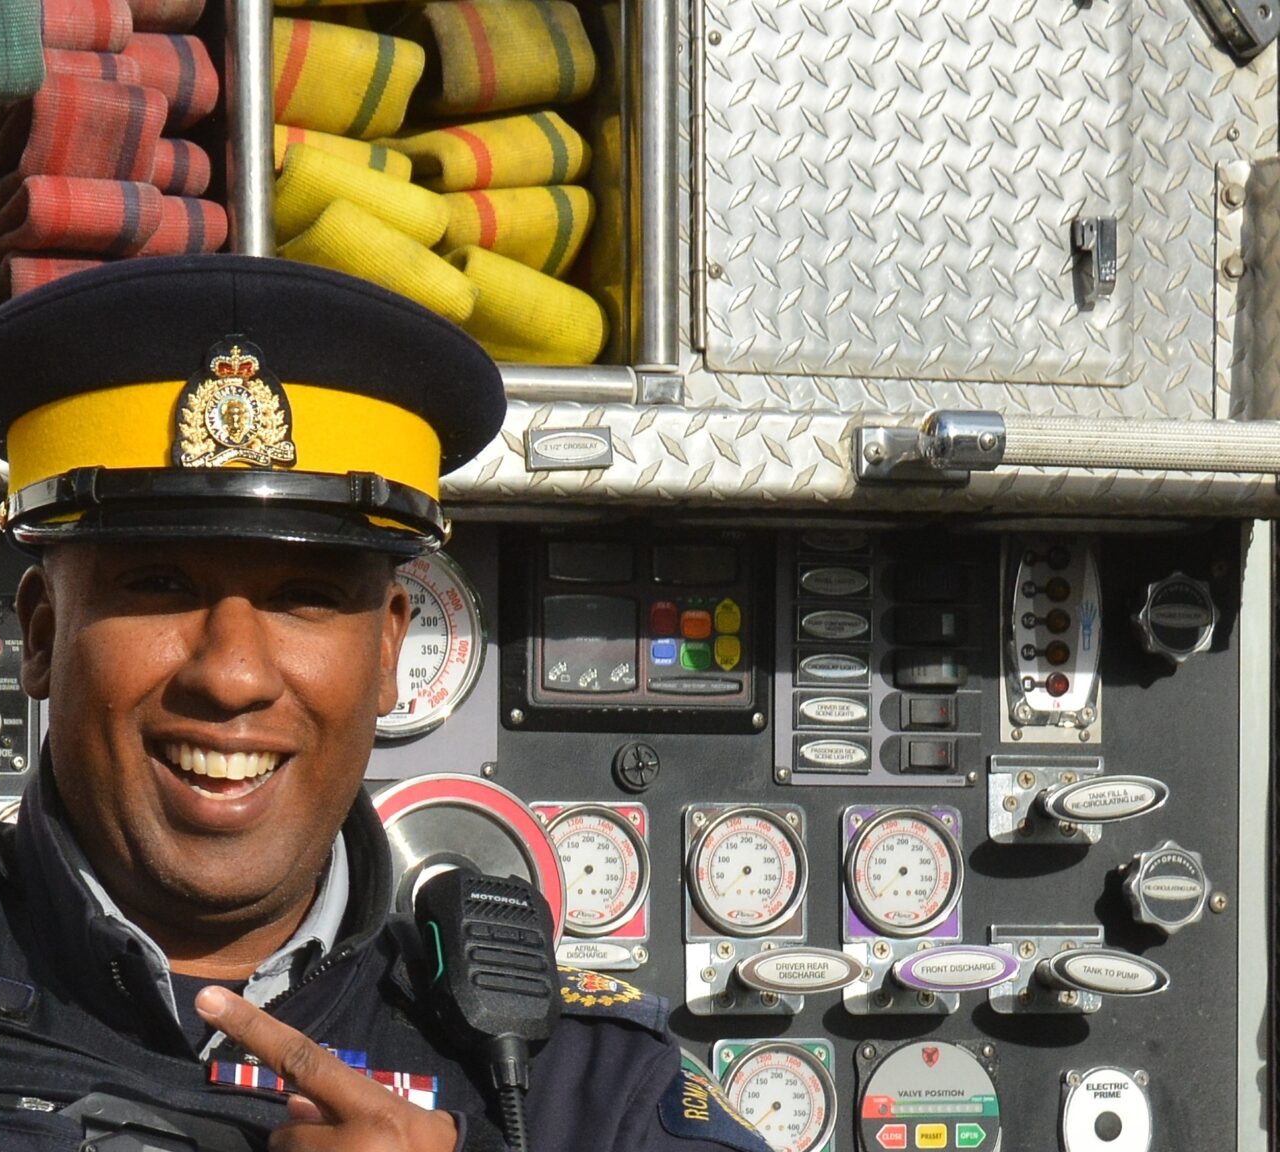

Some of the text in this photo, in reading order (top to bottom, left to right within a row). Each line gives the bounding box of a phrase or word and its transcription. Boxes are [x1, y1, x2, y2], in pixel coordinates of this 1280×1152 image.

[563, 442, 599, 450] CROSSLAY
[409, 593, 426, 605] 250
[446, 587, 463, 612] 2000
[420, 616, 439, 628] 300
[1022, 616, 1036, 626] 1/2
[420, 644, 439, 656] 350
[455, 639, 469, 665] 2400
[408, 667, 427, 679] 400
[410, 679, 424, 691] psi
[427, 686, 450, 710] 2800
[1088, 791, 1107, 801] TANK
[1107, 789, 1122, 799] FILL
[1071, 793, 1146, 811] RE-CIRCULATING LINE
[567, 818, 584, 829] 1200
[597, 819, 615, 832] 1600
[755, 818, 772, 832] 1600
[740, 836, 753, 844] 200
[567, 841, 580, 849] 150
[597, 842, 610, 850] 250
[725, 842, 738, 850] 150
[882, 844, 895, 852] 150
[911, 844, 924, 852] 250
[604, 856, 618, 864] 300
[763, 856, 775, 864] 300
[874, 857, 887, 865] 100
[919, 857, 932, 865] 300
[1161, 854, 1183, 865] OPEN
[606, 874, 619, 882] 350
[715, 872, 725, 880] 50
[764, 873, 777, 881] 350
[872, 873, 881, 881] 50
[920, 874, 933, 882] 350
[599, 888, 613, 896] 400
[758, 888, 771, 896] 400
[914, 888, 927, 896] 400
[470, 892, 529, 907] MOTOROLA
[574, 944, 599, 952] AERIAL
[566, 951, 609, 960] DISCHARGE
[774, 961, 829, 971] DRIVER REAR
[920, 961, 997, 975] FRONT DISCHARGE
[778, 971, 827, 980] DISCHARGE
[1082, 964, 1140, 982] TANK TO PUMP
[755, 1054, 773, 1066] 1200
[785, 1055, 802, 1068] 1600
[770, 1071, 784, 1080] 200
[755, 1077, 768, 1086] 150
[785, 1078, 798, 1087] 250
[1086, 1082, 1129, 1091] ELECTRIC
[747, 1091, 760, 1099] 100
[792, 1092, 806, 1100] 300
[897, 1088, 965, 1098] VALVE POSITION
[1093, 1090, 1122, 1099] PRIME
[745, 1107, 755, 1115] 50
[793, 1109, 807, 1117] 350
[787, 1123, 800, 1131] 400
[882, 1131, 903, 1141] CLOSE
[920, 1131, 943, 1141] PRESET
[960, 1131, 979, 1140] OPEN
